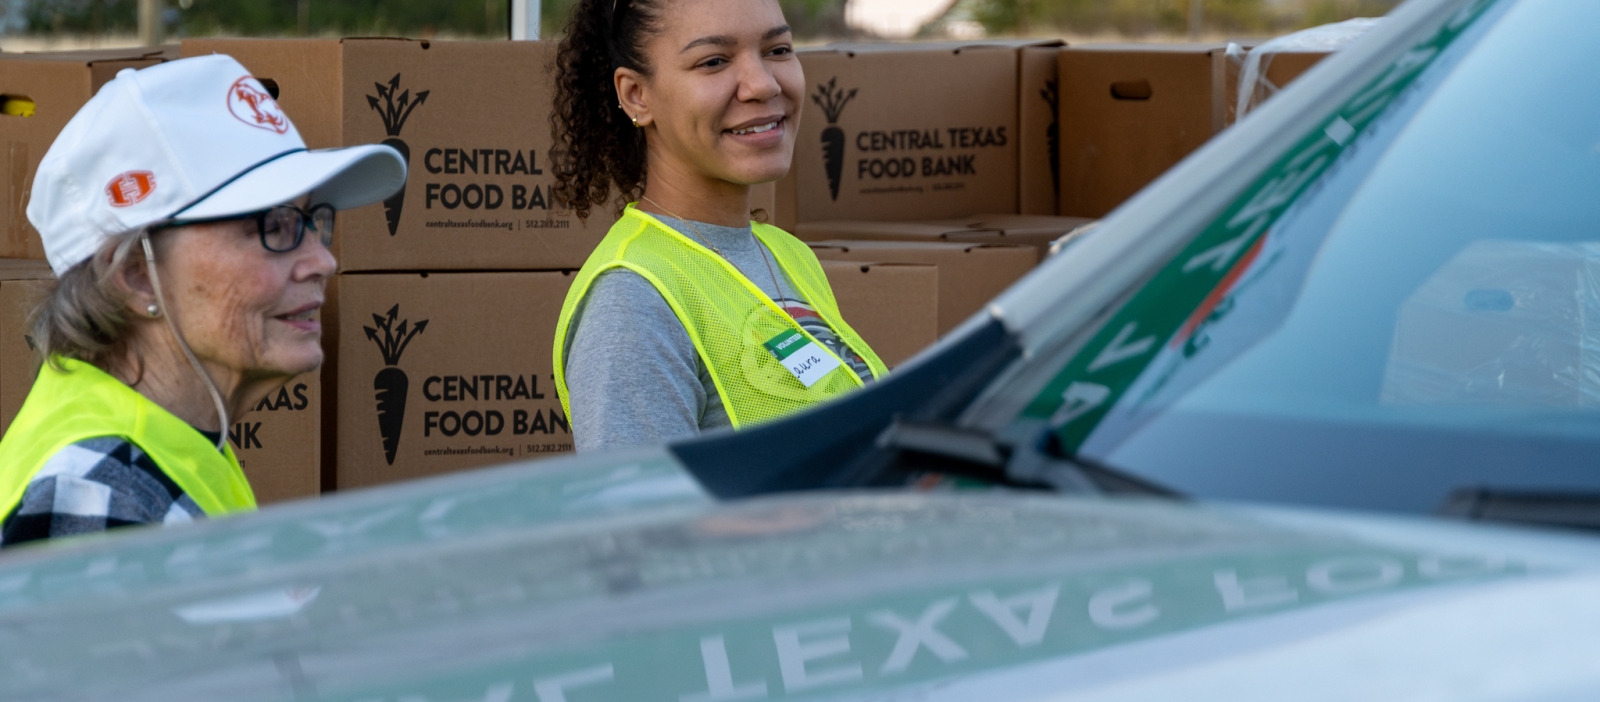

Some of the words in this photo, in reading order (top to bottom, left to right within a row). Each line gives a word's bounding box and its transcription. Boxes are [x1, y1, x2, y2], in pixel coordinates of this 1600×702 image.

[856, 129, 943, 151] CENTRAL
[947, 126, 1007, 148] TEXAS
[424, 148, 543, 175] CENTRAL
[858, 156, 915, 179] FOOD
[922, 155, 976, 176] BANK
[425, 183, 504, 210] FOOD
[425, 218, 513, 231] centraltexasfoodbank.org
[793, 355, 821, 378] aura
[251, 383, 308, 411] XAS
[423, 375, 544, 401] CENTRAL
[229, 422, 262, 449] NK
[424, 410, 504, 437] FOOD
[513, 408, 573, 435] BAN
[424, 445, 514, 457] centraltexasfoodbank.org
[527, 444, 572, 453] 512.282.2111
